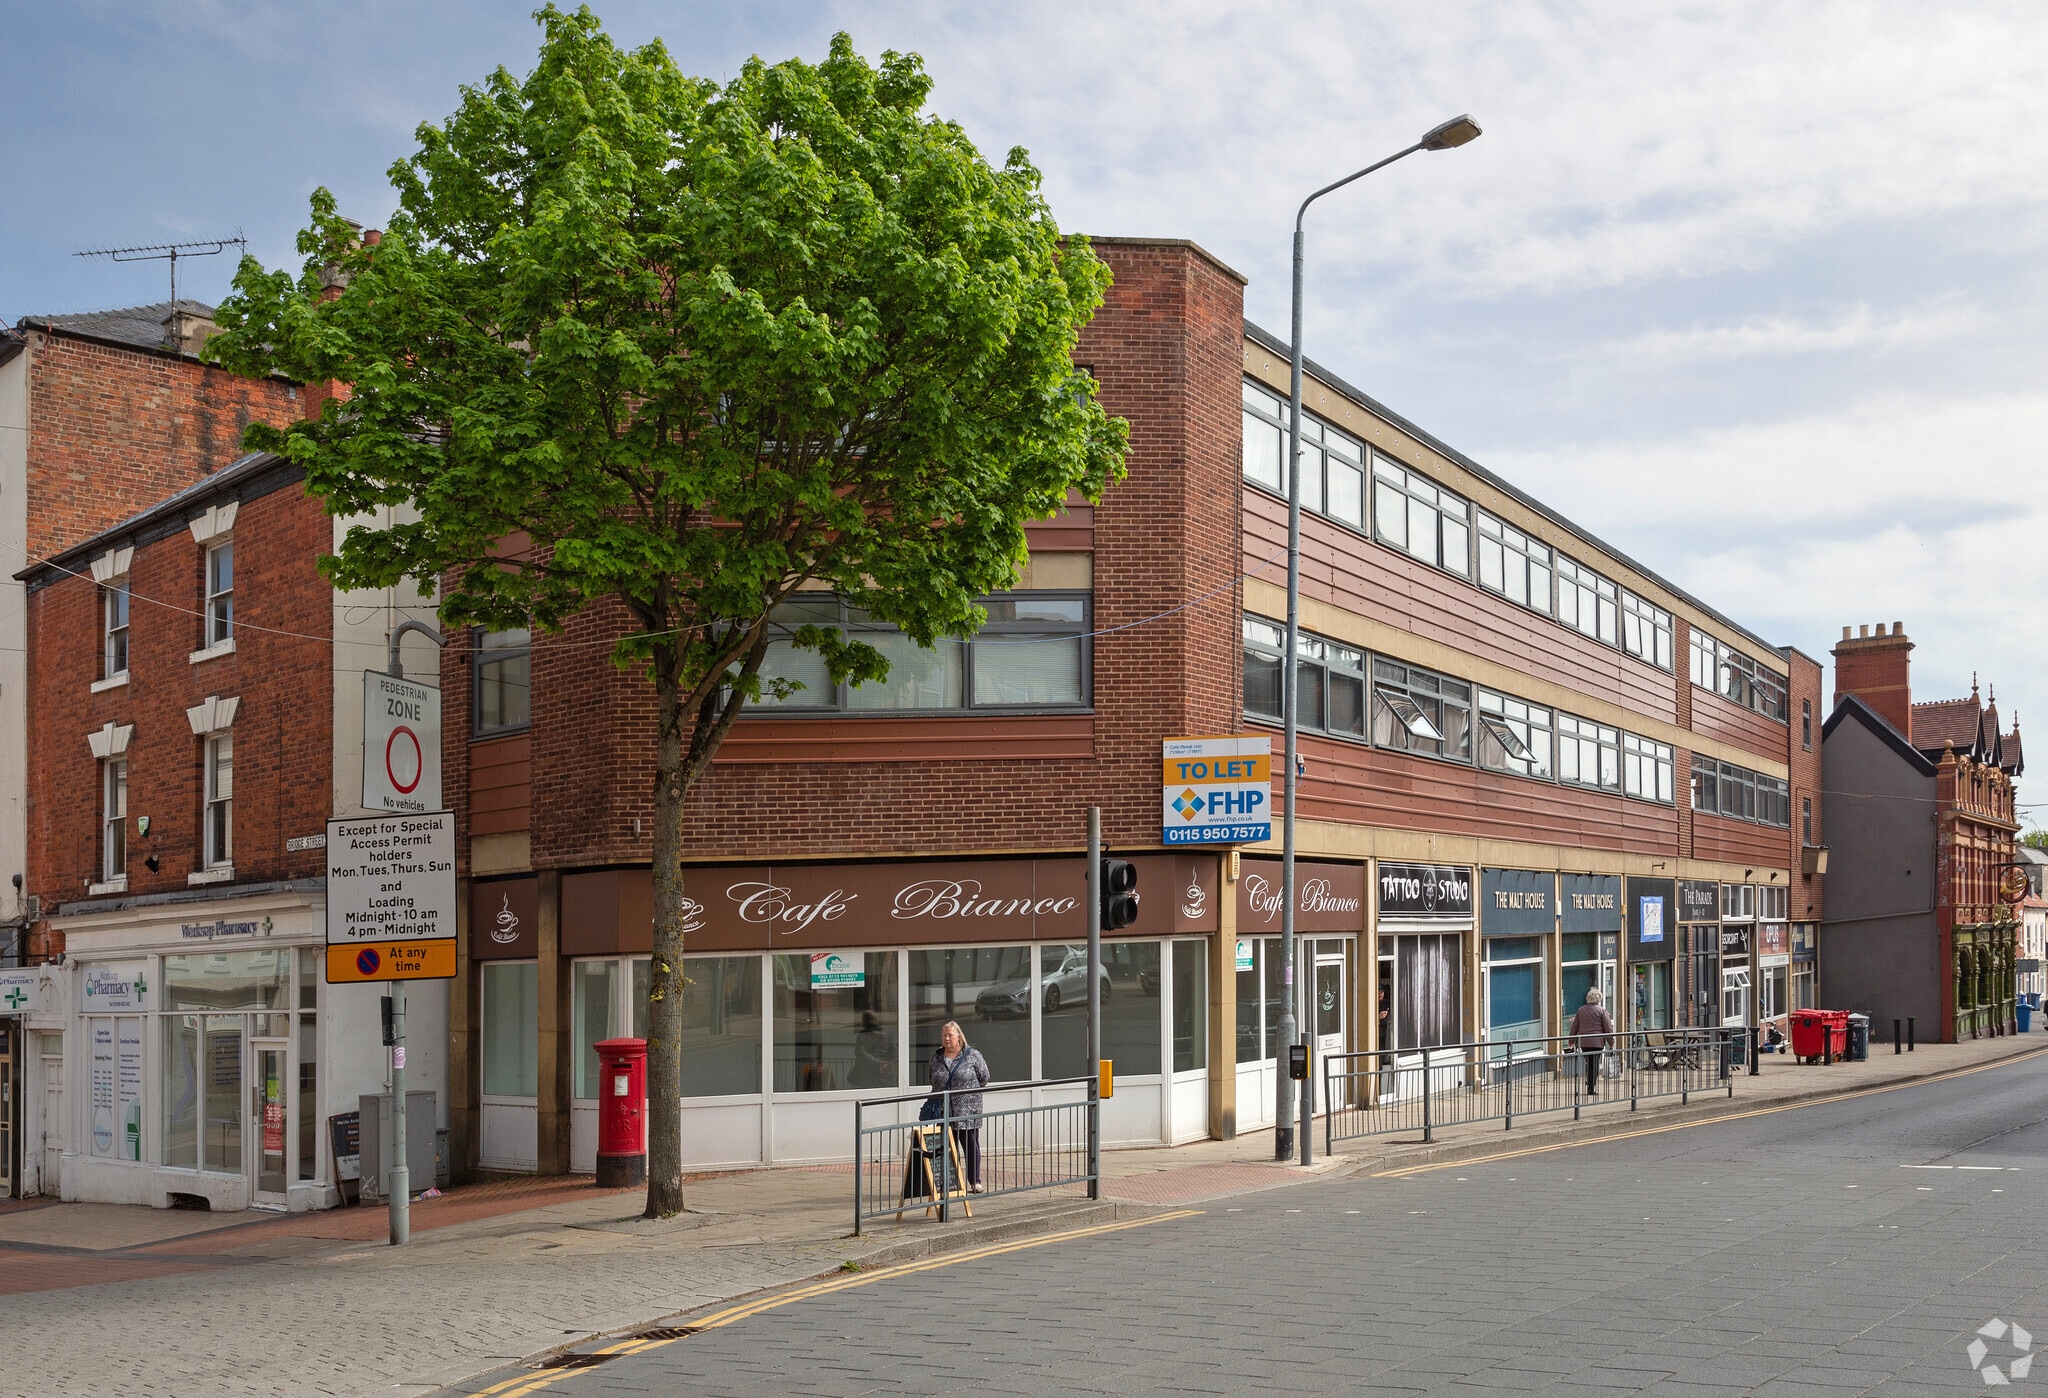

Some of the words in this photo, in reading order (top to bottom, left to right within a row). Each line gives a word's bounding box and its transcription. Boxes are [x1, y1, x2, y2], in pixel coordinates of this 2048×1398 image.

[380, 680, 428, 702] PEDESTRIAN
[387, 698, 421, 721] ZONE
[1177, 762, 1208, 779] TO
[1214, 761, 1257, 778] LET
[383, 796, 394, 808] No
[395, 798, 425, 811] vehicles
[1208, 790, 1264, 815] FHP
[338, 824, 377, 837] Except
[380, 823, 397, 833] for
[401, 819, 443, 833] Special
[1169, 829, 1200, 841] 0115
[1203, 827, 1230, 839] 950
[1231, 826, 1265, 838] 7577
[305, 836, 324, 848] STREET
[350, 838, 390, 850] Access
[393, 834, 432, 846] Permit
[369, 850, 412, 862] holders
[429, 861, 451, 872] Sun
[380, 880, 402, 891] and
[1381, 874, 1420, 901] TATTOO
[1438, 879, 1468, 903] STUDIO
[368, 896, 414, 908] Loading
[1301, 878, 1360, 913] Bianco
[1495, 891, 1507, 909] THE
[1509, 892, 1523, 909] MALT
[1525, 892, 1545, 909] HOUSE
[1572, 893, 1583, 909] THE
[1583, 894, 1595, 909] MALT
[1596, 894, 1614, 909] HOUSE
[1684, 888, 1694, 905] THE
[1695, 889, 1712, 905] PARADE
[726, 882, 858, 935] Café
[891, 879, 1081, 919] Bianco
[346, 910, 397, 923] Midnight
[404, 909, 417, 920] 10
[420, 910, 438, 919] am
[181, 923, 214, 940] Worksop
[215, 920, 258, 937] Pharmacy
[347, 926, 356, 937] 4
[359, 929, 376, 938] pm
[385, 922, 436, 935] Midnight
[389, 947, 402, 959] At
[407, 949, 427, 959] any
[395, 961, 421, 971] time
[94, 979, 131, 997] Pharmacy
